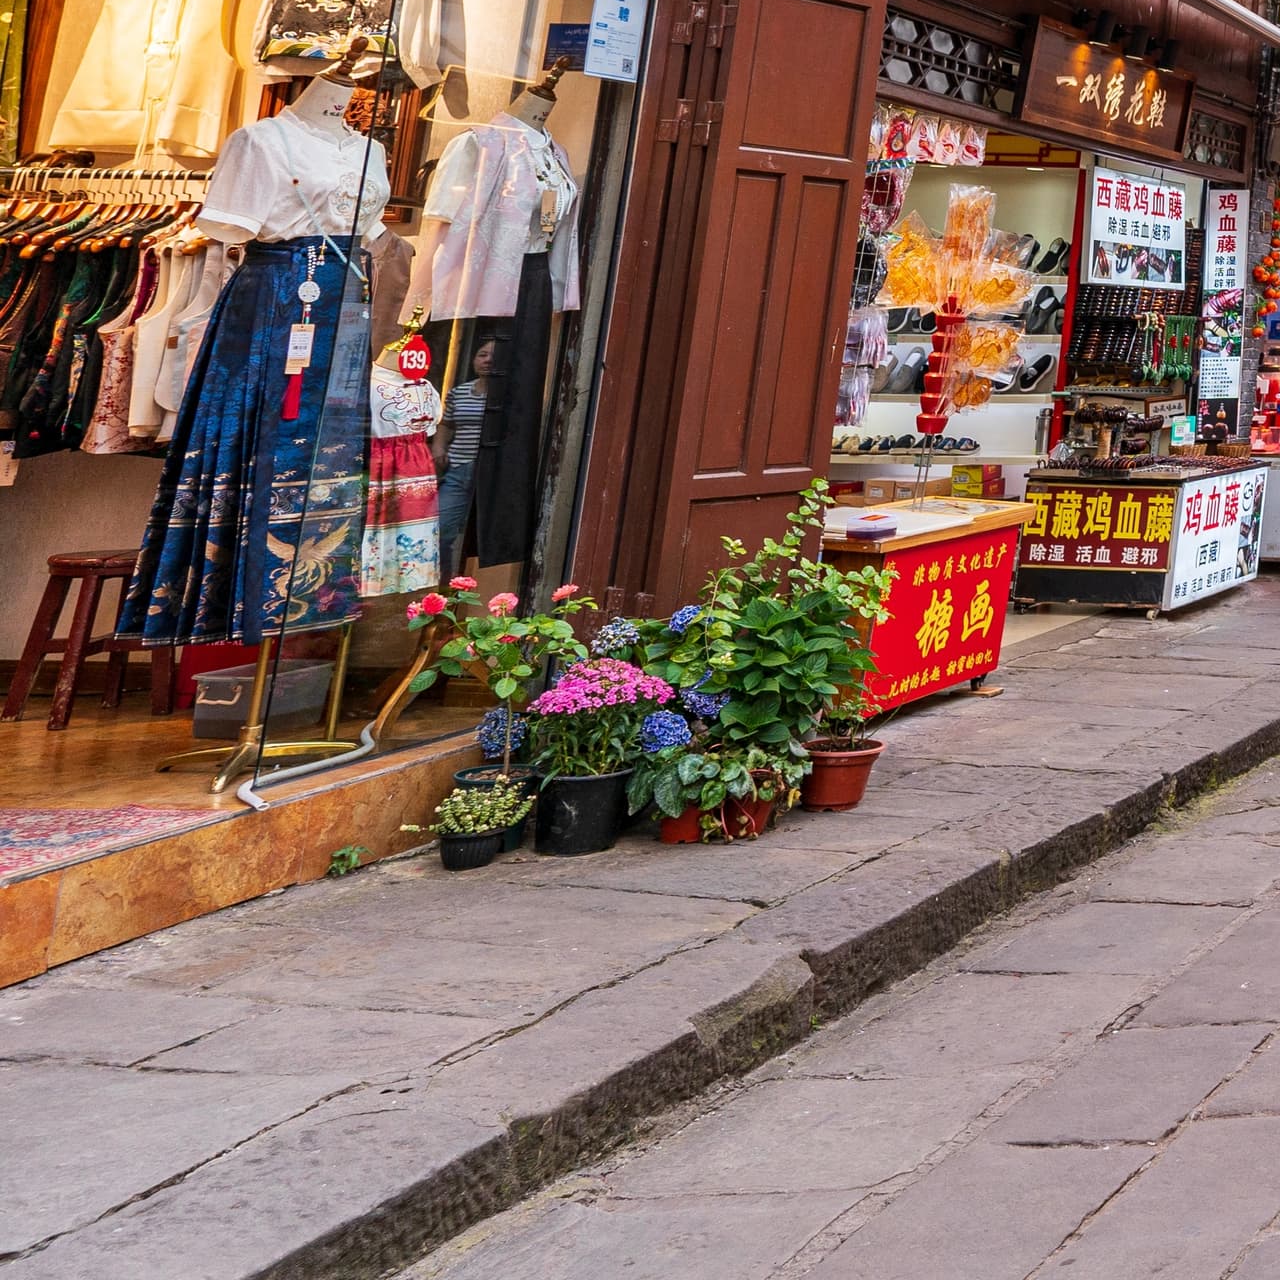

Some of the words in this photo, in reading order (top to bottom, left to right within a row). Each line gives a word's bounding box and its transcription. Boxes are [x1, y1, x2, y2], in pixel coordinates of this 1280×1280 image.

[1055, 72, 1167, 129] 一双绣花鞋
[1096, 175, 1183, 222] 西藏鸡血藤
[1107, 216, 1128, 239] 除湿
[1130, 219, 1150, 240] 活血
[1215, 192, 1238, 254] 鸡血藤
[1214, 255, 1237, 267] 除湿
[1214, 267, 1237, 278] 活血
[1023, 490, 1175, 544] 西藏鸡血藤
[1183, 480, 1242, 537] 鸡血藤
[912, 543, 1008, 587] 非物质文化遗产
[1029, 543, 1066, 562] 除湿
[1076, 545, 1112, 564] 活血
[1121, 547, 1159, 566] 避邪
[914, 578, 994, 658] 糖画
